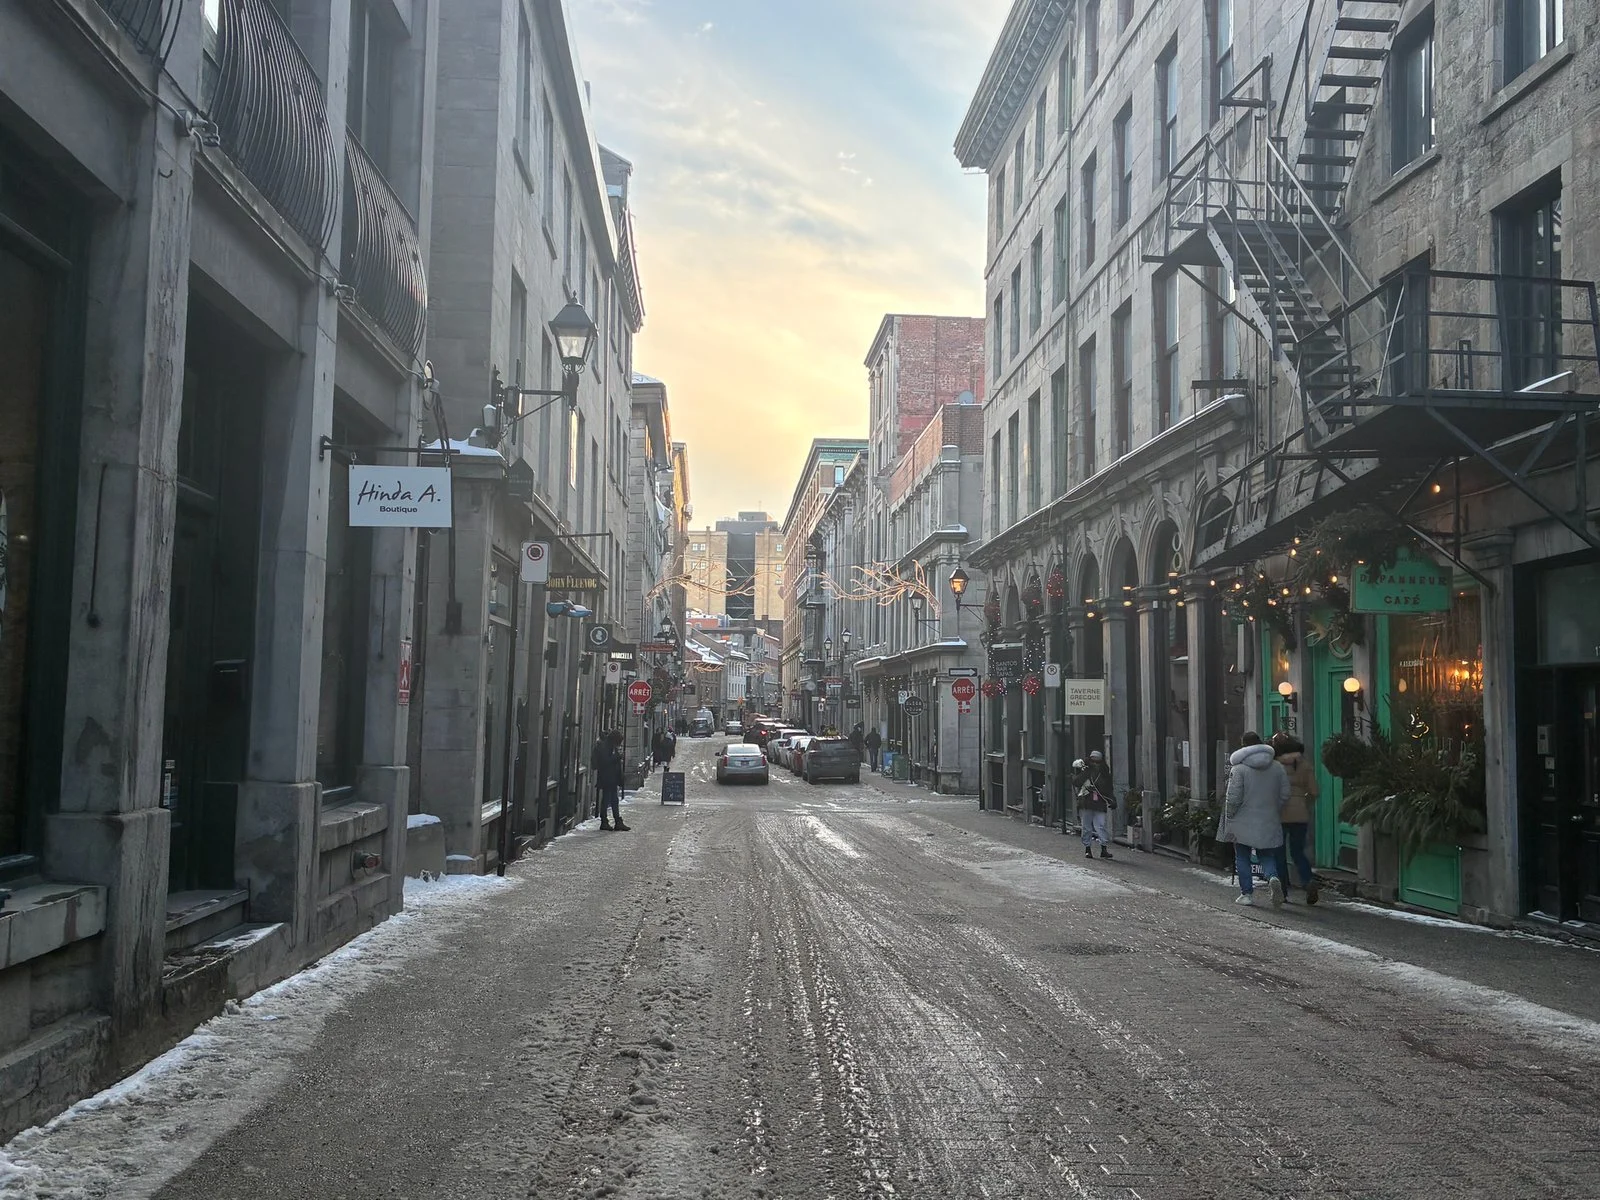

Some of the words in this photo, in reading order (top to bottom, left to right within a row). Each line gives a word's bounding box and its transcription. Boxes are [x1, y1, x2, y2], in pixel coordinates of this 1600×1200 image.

[357, 480, 413, 505] Hinda
[417, 484, 441, 502] A.
[546, 577, 565, 588] JOHN
[1359, 573, 1448, 586] DPANNEUR
[1383, 594, 1421, 605] CAFÉ
[629, 687, 650, 697] ARRÊT
[952, 684, 974, 694] ARRÊT
